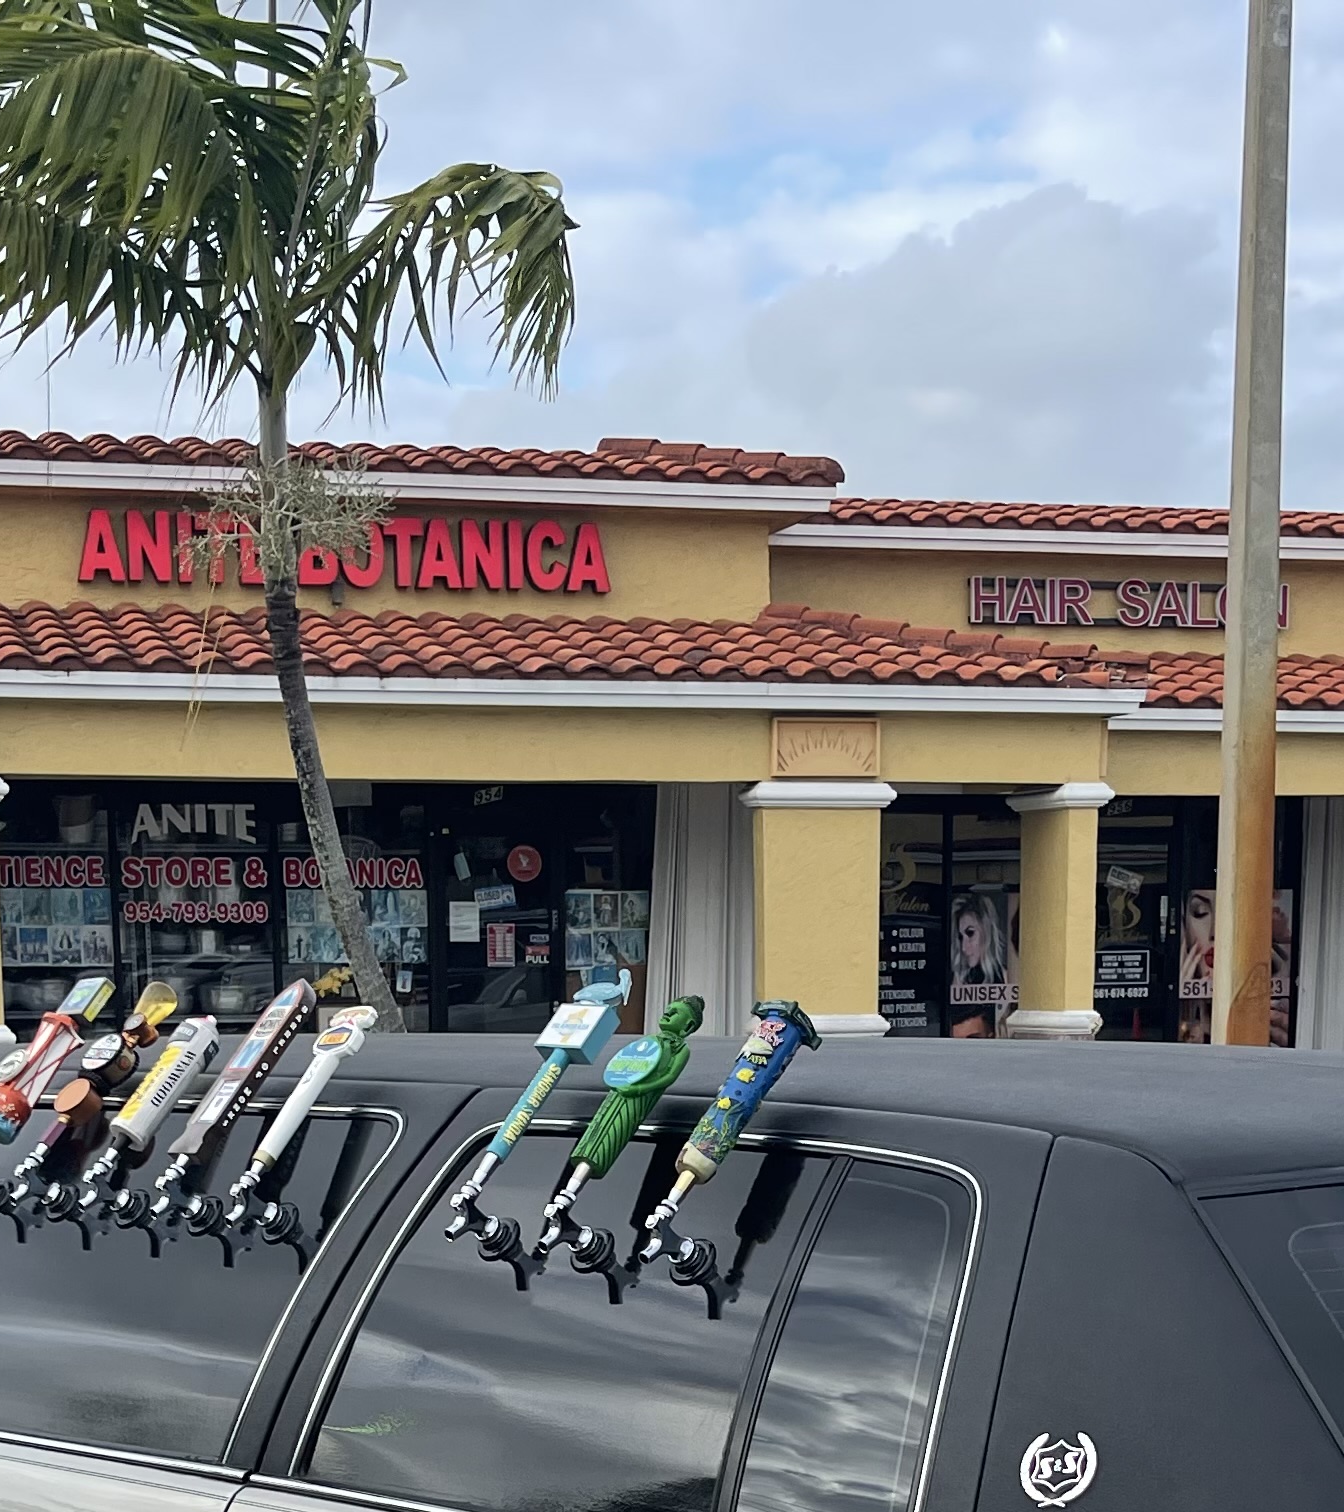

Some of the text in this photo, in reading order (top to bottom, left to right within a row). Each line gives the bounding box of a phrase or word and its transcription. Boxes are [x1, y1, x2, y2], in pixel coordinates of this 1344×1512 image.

[79, 508, 611, 594] ANITE BOTANICA
[969, 575, 1290, 629] HAIR SAL
[475, 787, 502, 804] 954
[131, 803, 257, 845] ANITE
[120, 856, 233, 889] STORE
[243, 856, 268, 889] &
[282, 856, 424, 889] BONICA
[124, 901, 269, 924] 954-793-9309
[525, 954, 550, 965] PULL
[897, 959, 916, 971] MAKE
[916, 959, 926, 970] UP
[952, 985, 1008, 1002] UNISEX
[527, 1062, 563, 1109] SANDBAR
[1037, 1451, 1080, 1480] S&S
